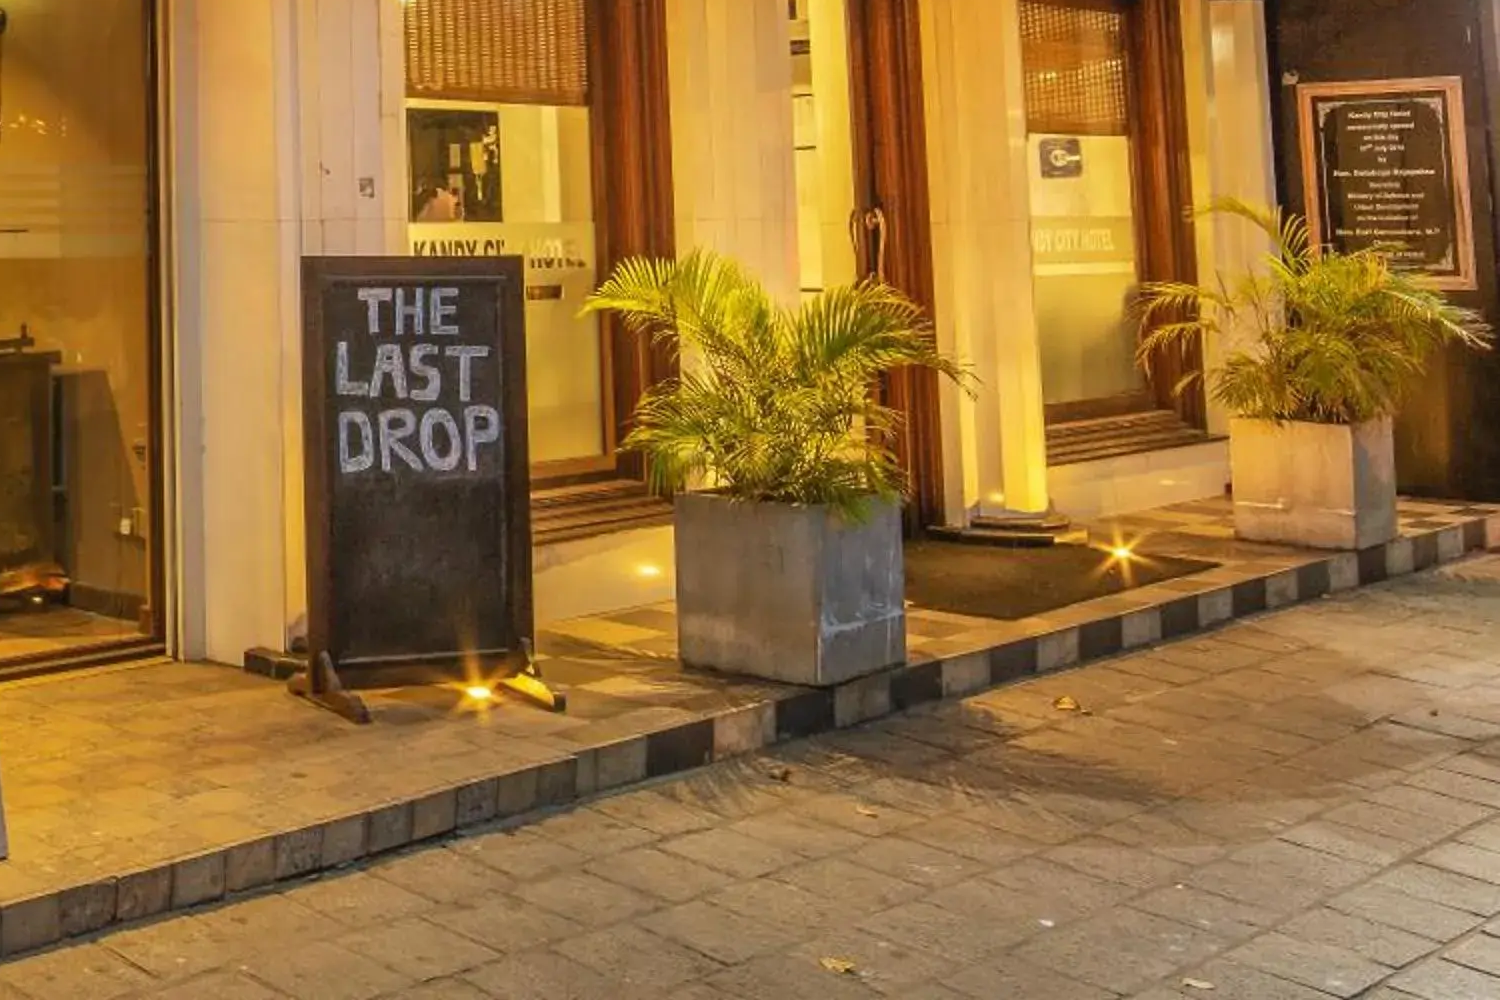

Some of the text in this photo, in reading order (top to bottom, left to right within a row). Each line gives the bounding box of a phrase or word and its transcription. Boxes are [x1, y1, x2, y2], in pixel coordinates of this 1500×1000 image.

[357, 287, 459, 335] THE
[336, 341, 489, 401] LAST
[338, 405, 500, 473] DROP
